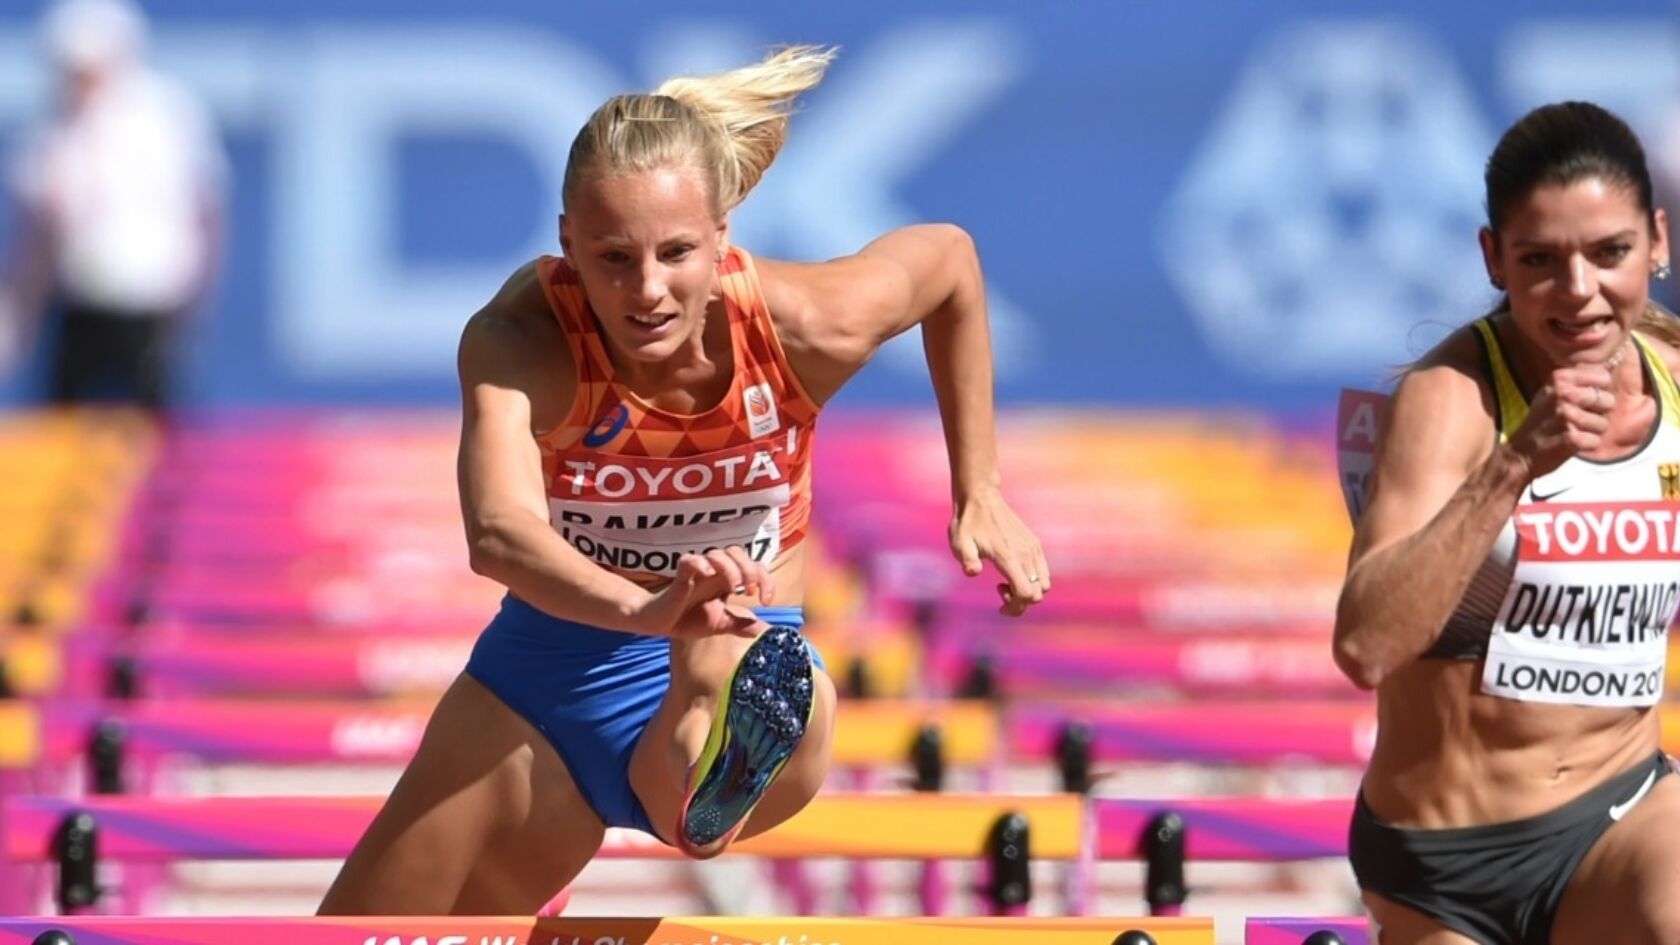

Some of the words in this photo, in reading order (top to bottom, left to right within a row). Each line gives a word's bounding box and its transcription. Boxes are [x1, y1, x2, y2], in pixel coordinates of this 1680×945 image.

[562, 450, 782, 498] TOYOTA
[1520, 508, 1680, 555] TOYOT
[1504, 582, 1680, 643] DUTKIEWIC
[1495, 663, 1628, 697] LONDON
[1631, 667, 1663, 697] 20
